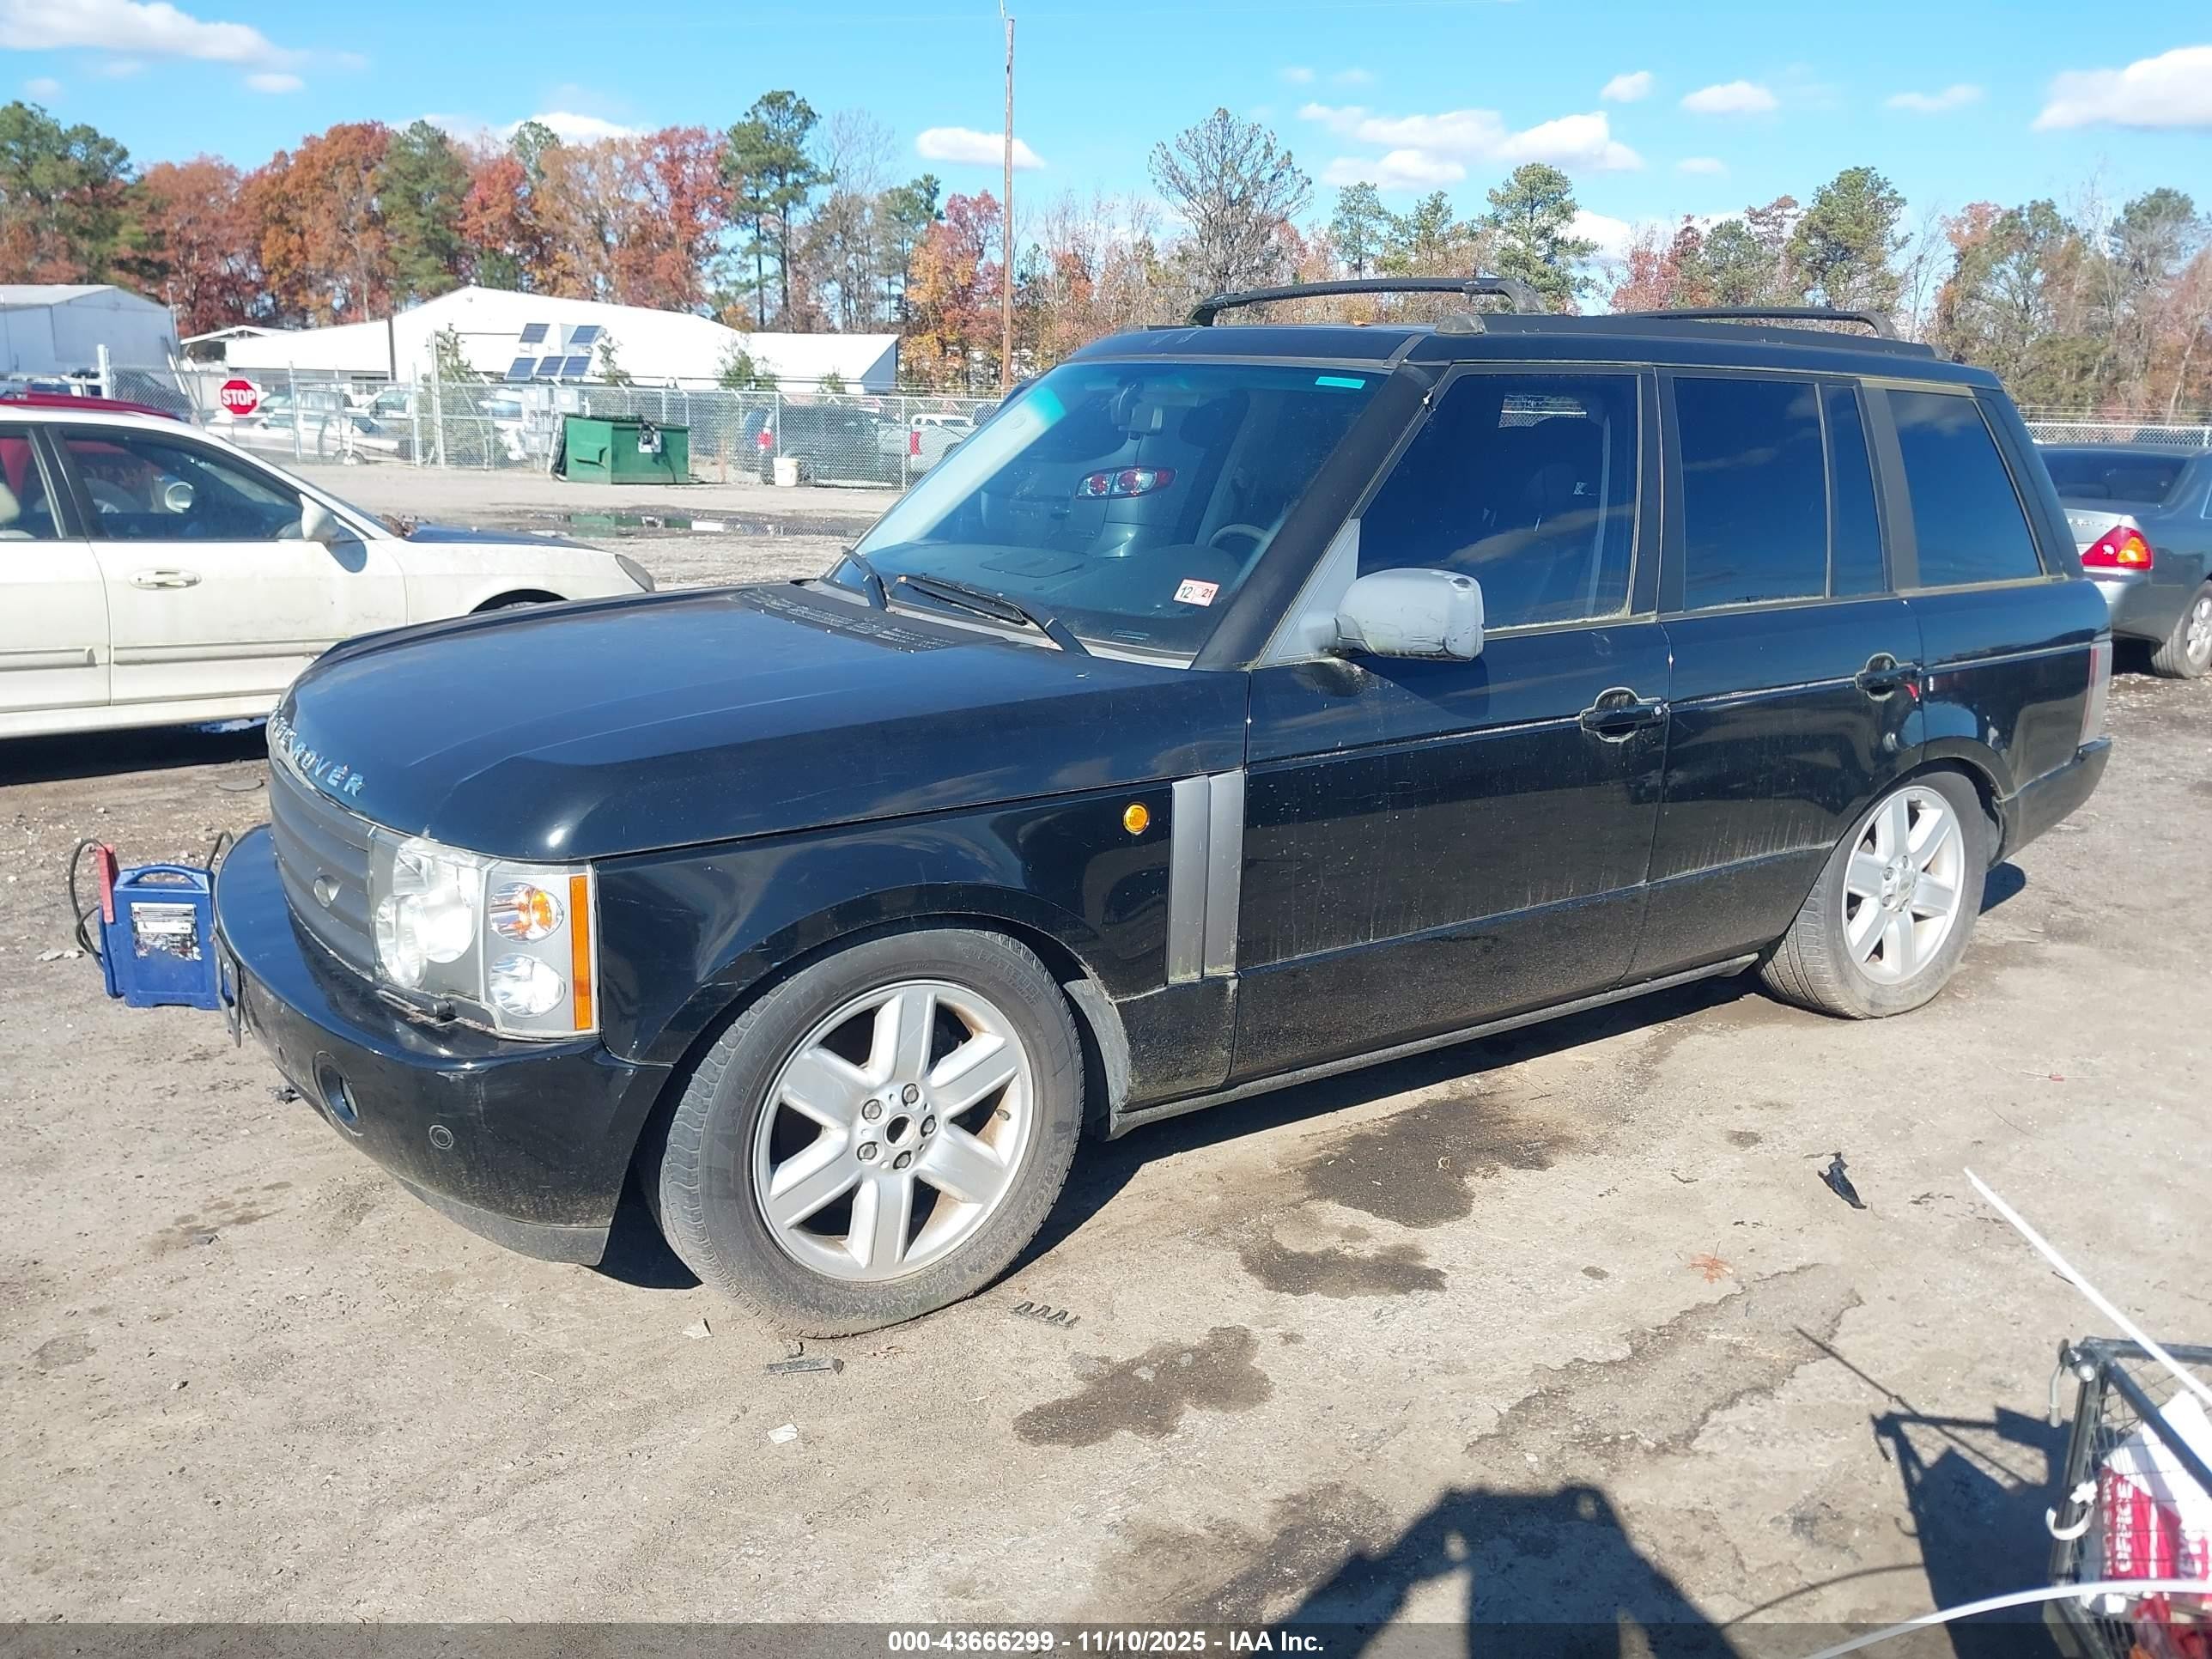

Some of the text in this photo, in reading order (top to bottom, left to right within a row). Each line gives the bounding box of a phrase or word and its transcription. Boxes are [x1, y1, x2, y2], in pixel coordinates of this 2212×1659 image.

[222, 389, 257, 406] STOP
[1180, 586, 1213, 599] 12 21
[293, 741, 364, 797] ROVER
